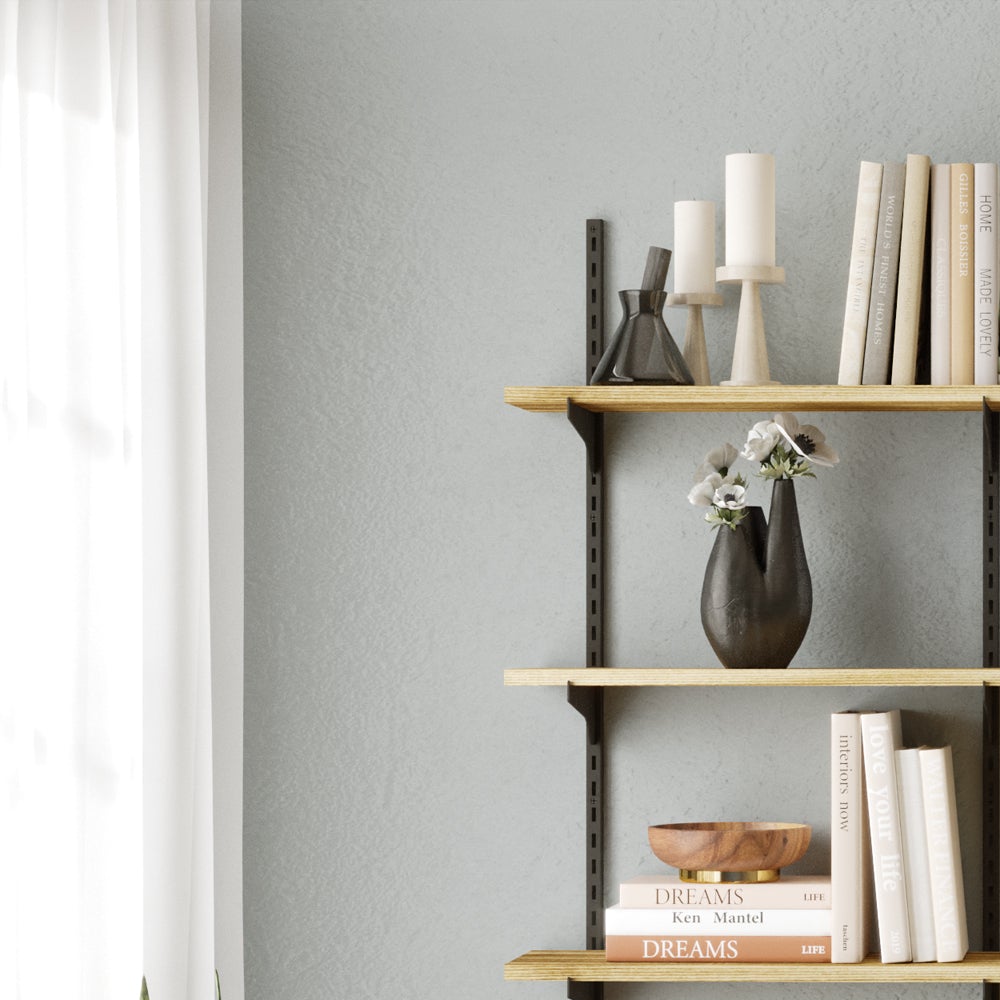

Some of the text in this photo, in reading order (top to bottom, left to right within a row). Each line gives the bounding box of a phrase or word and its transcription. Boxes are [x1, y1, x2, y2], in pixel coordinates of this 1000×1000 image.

[959, 173, 969, 278] GILLES BOISSIER
[873, 194, 896, 345] WORLD'S FINEST HOMES
[980, 195, 992, 357] HOME MADE LOVELY
[839, 734, 852, 833] interiors now
[868, 723, 901, 893] love your life
[655, 888, 744, 905] DREAMS
[803, 893, 826, 902] LIFE
[672, 911, 765, 924] Ken Mantel
[642, 940, 739, 959] DREAMS
[801, 945, 826, 955] LIFE
[890, 930, 902, 955] 2019
